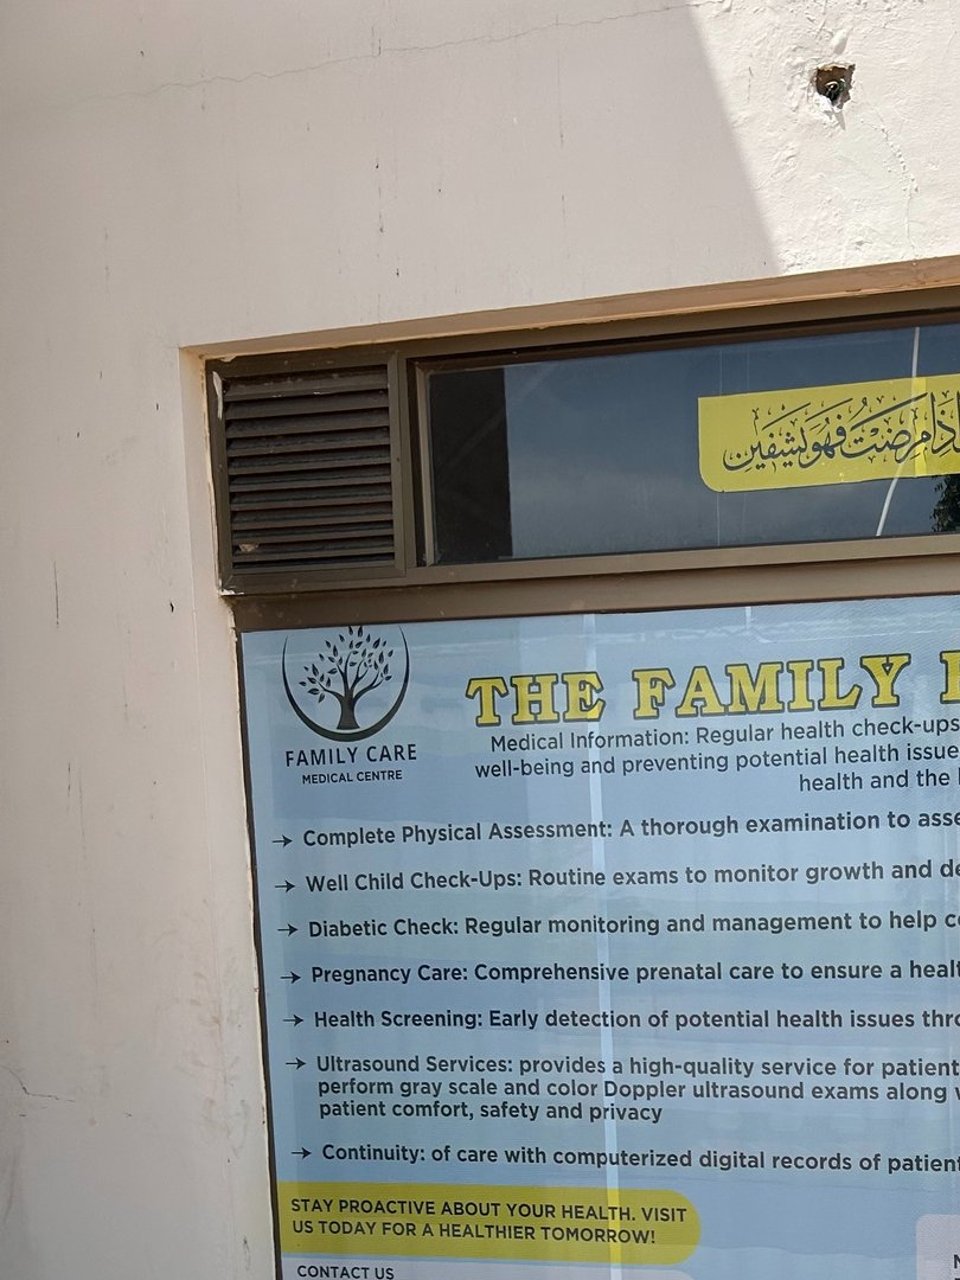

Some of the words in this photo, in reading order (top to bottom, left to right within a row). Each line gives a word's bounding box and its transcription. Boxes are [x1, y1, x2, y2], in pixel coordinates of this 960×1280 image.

[465, 670, 606, 727] THE
[631, 652, 912, 719] FAMILY
[491, 731, 564, 753] Medical
[570, 728, 689, 749] Information:
[696, 723, 775, 747] Regular
[781, 719, 845, 741] health
[851, 715, 960, 737] check-ups
[285, 746, 358, 768] FAMILY
[366, 743, 417, 763] CARE
[474, 757, 575, 778] well-being
[580, 755, 616, 775] and
[622, 752, 729, 777] preventing
[735, 746, 827, 772] potential
[834, 743, 899, 765] health
[301, 772, 354, 785] MEDICAL
[356, 769, 403, 782] CENTRE
[799, 771, 863, 792] health
[870, 768, 909, 789] and
[915, 768, 951, 788] the
[303, 826, 396, 849] Complete
[402, 822, 482, 846] Physical
[488, 820, 612, 840] Assessment:
[619, 819, 635, 838] A
[640, 815, 739, 838] thorough
[745, 811, 880, 833] examination
[886, 810, 911, 829] to
[311, 966, 412, 986] Pregnancy
[417, 964, 468, 981] Care:
[474, 962, 630, 984] Comprehensive
[636, 961, 722, 984] prenatal
[729, 965, 775, 980] care
[780, 962, 804, 980] to
[810, 964, 883, 980] ensure
[889, 964, 902, 979] a
[314, 1010, 375, 1028] Health
[381, 1009, 483, 1030] Screening:
[489, 1009, 539, 1030] Early
[544, 1009, 641, 1028] detection
[647, 1009, 669, 1028] of
[675, 1009, 769, 1032] potential
[776, 1009, 843, 1028] health
[850, 1009, 915, 1028] issues
[316, 1055, 420, 1073] Ultrasound
[426, 1055, 513, 1073] Services:
[519, 1055, 606, 1076] provides
[612, 1060, 623, 1075] a
[629, 1056, 755, 1079] high-quality
[761, 1057, 837, 1076] service
[843, 1057, 875, 1076] for
[319, 1099, 387, 1120] patient
[391, 1099, 474, 1121] comfort,
[480, 1100, 540, 1122] safety
[546, 1101, 583, 1120] and
[589, 1102, 663, 1124] privacy
[291, 1198, 334, 1213] STAY
[338, 1199, 436, 1215] PROACTIVE
[440, 1201, 501, 1217] ABOUT
[506, 1203, 556, 1219] YOUR
[561, 1204, 636, 1222] HEALTH.
[640, 1207, 688, 1223] VISIT
[292, 1219, 314, 1234] US
[317, 1220, 377, 1235] TODAY
[381, 1221, 417, 1237] FOR
[421, 1222, 435, 1237] A
[438, 1223, 536, 1241] HEALTHIER
[540, 1226, 656, 1244] TOMORROW!
[296, 1264, 370, 1280] CONTACT
[374, 1267, 395, 1280] US
